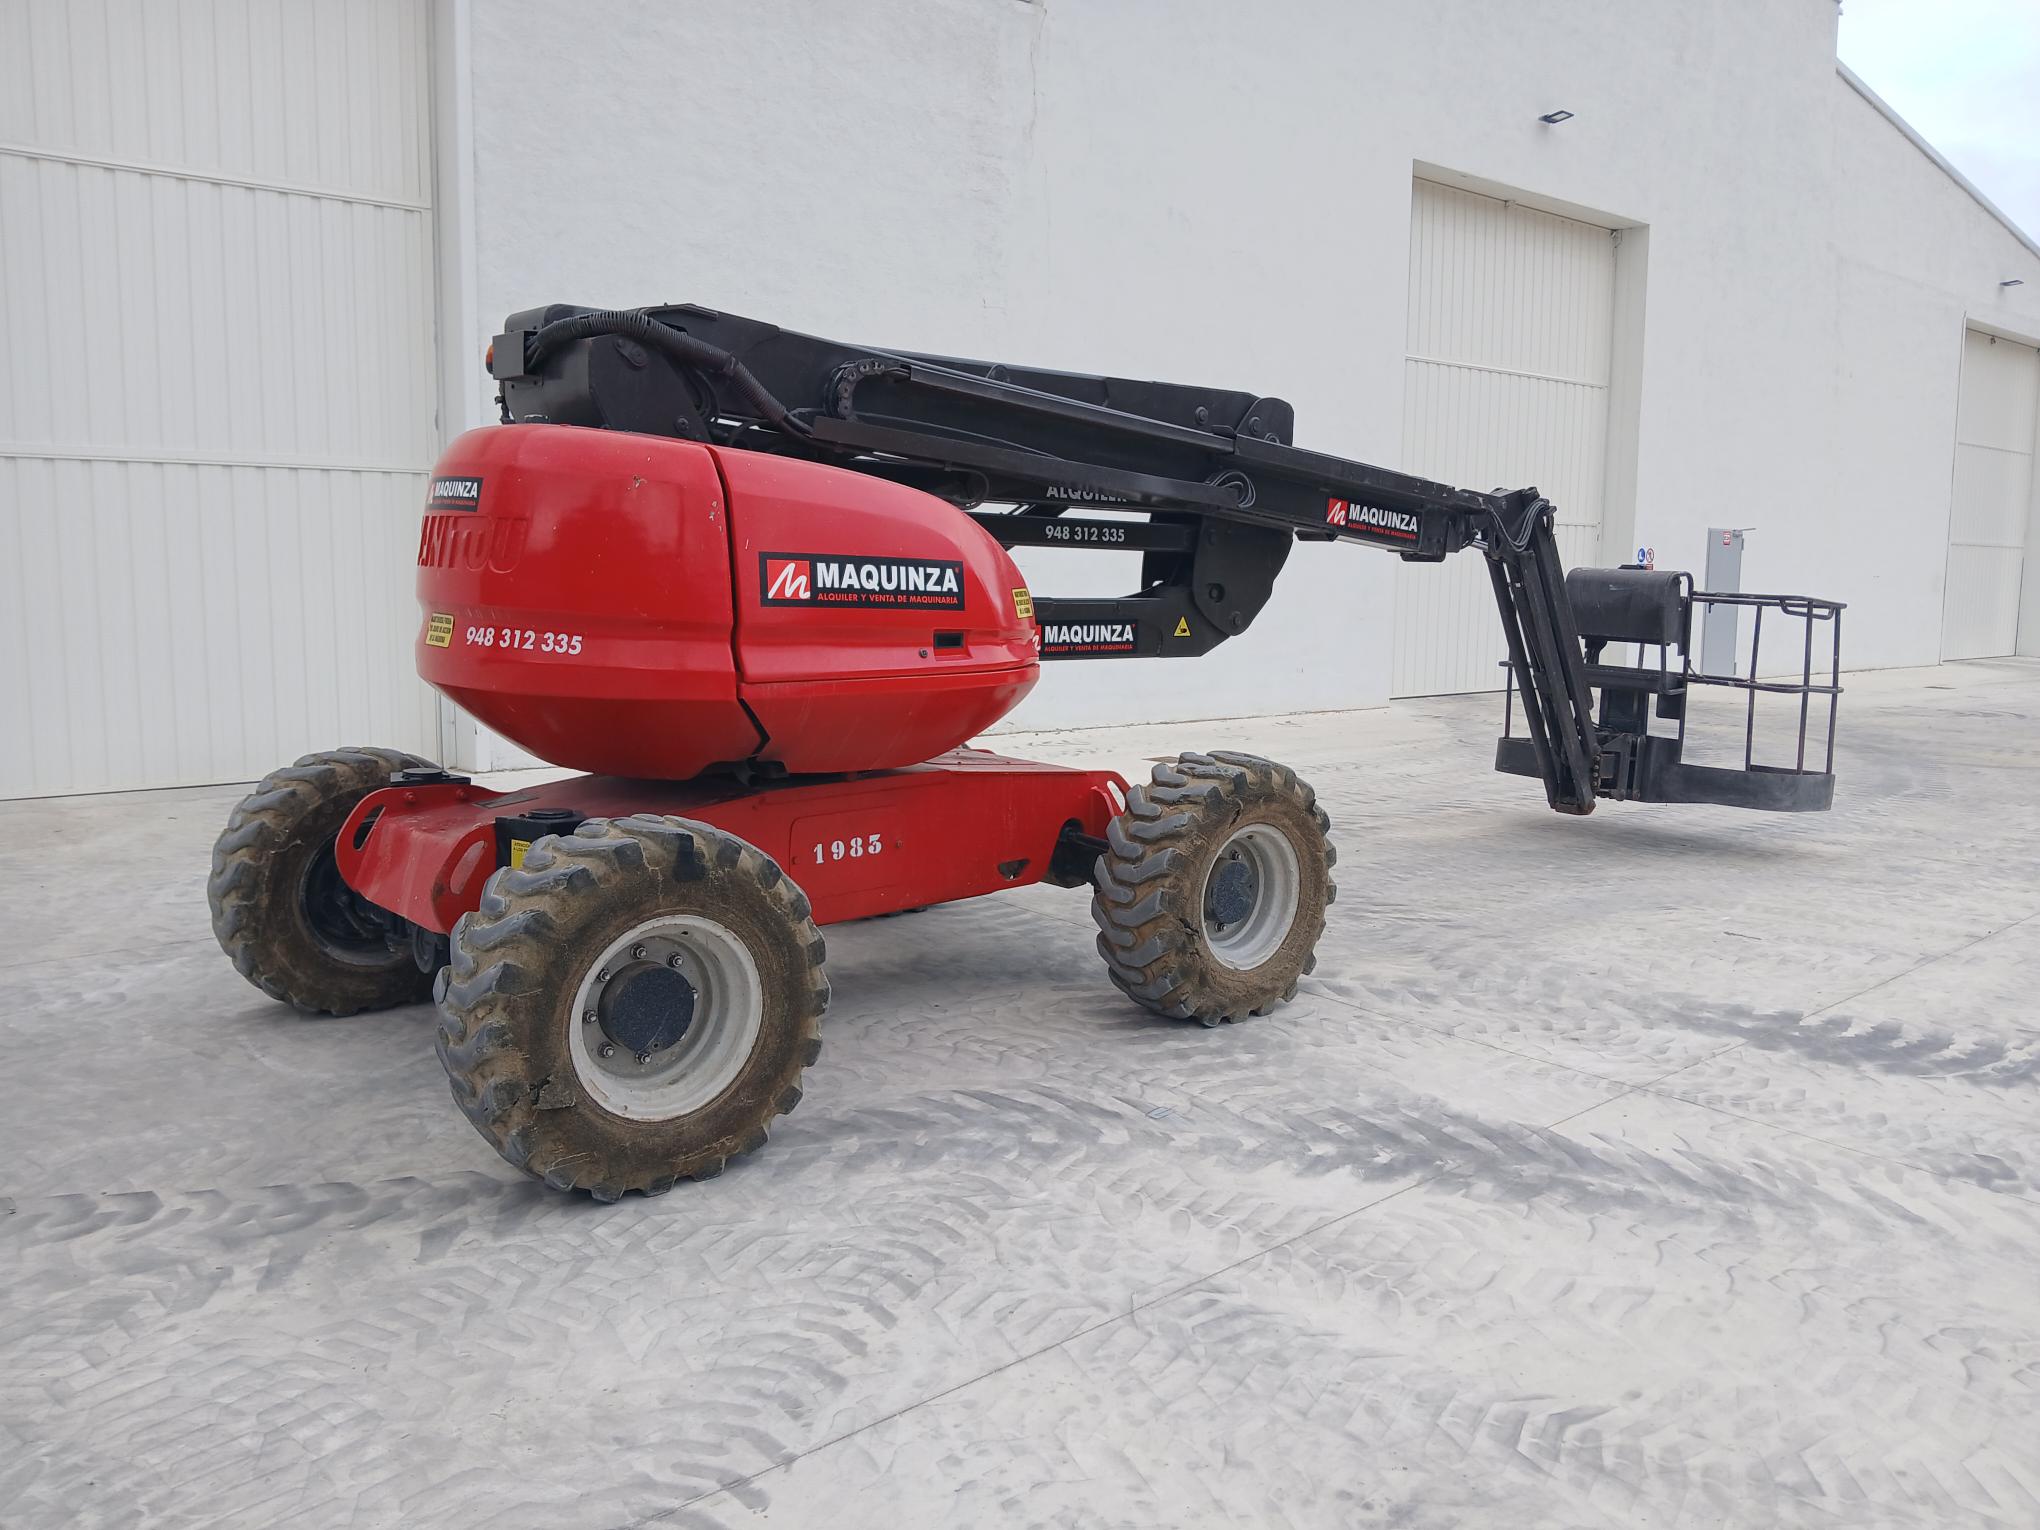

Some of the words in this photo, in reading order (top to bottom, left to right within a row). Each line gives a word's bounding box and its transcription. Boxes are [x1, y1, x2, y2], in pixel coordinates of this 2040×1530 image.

[434, 480, 478, 498] MAQUINZA
[1348, 503, 1418, 533] MAQUINZA
[1045, 525, 1070, 539] 948
[1074, 526, 1098, 541] 312
[1101, 527, 1125, 542] 335
[816, 562, 959, 593] MAQUINZA
[817, 592, 858, 602] ALQUILER
[861, 593, 867, 602] Y
[869, 594, 896, 603] VENTA
[898, 595, 907, 603] DE
[909, 595, 958, 605] MAQUINARIA
[466, 626, 495, 647] 948
[499, 628, 536, 650] 312
[541, 632, 583, 655] 335
[1044, 624, 1134, 644] MAQUINZA
